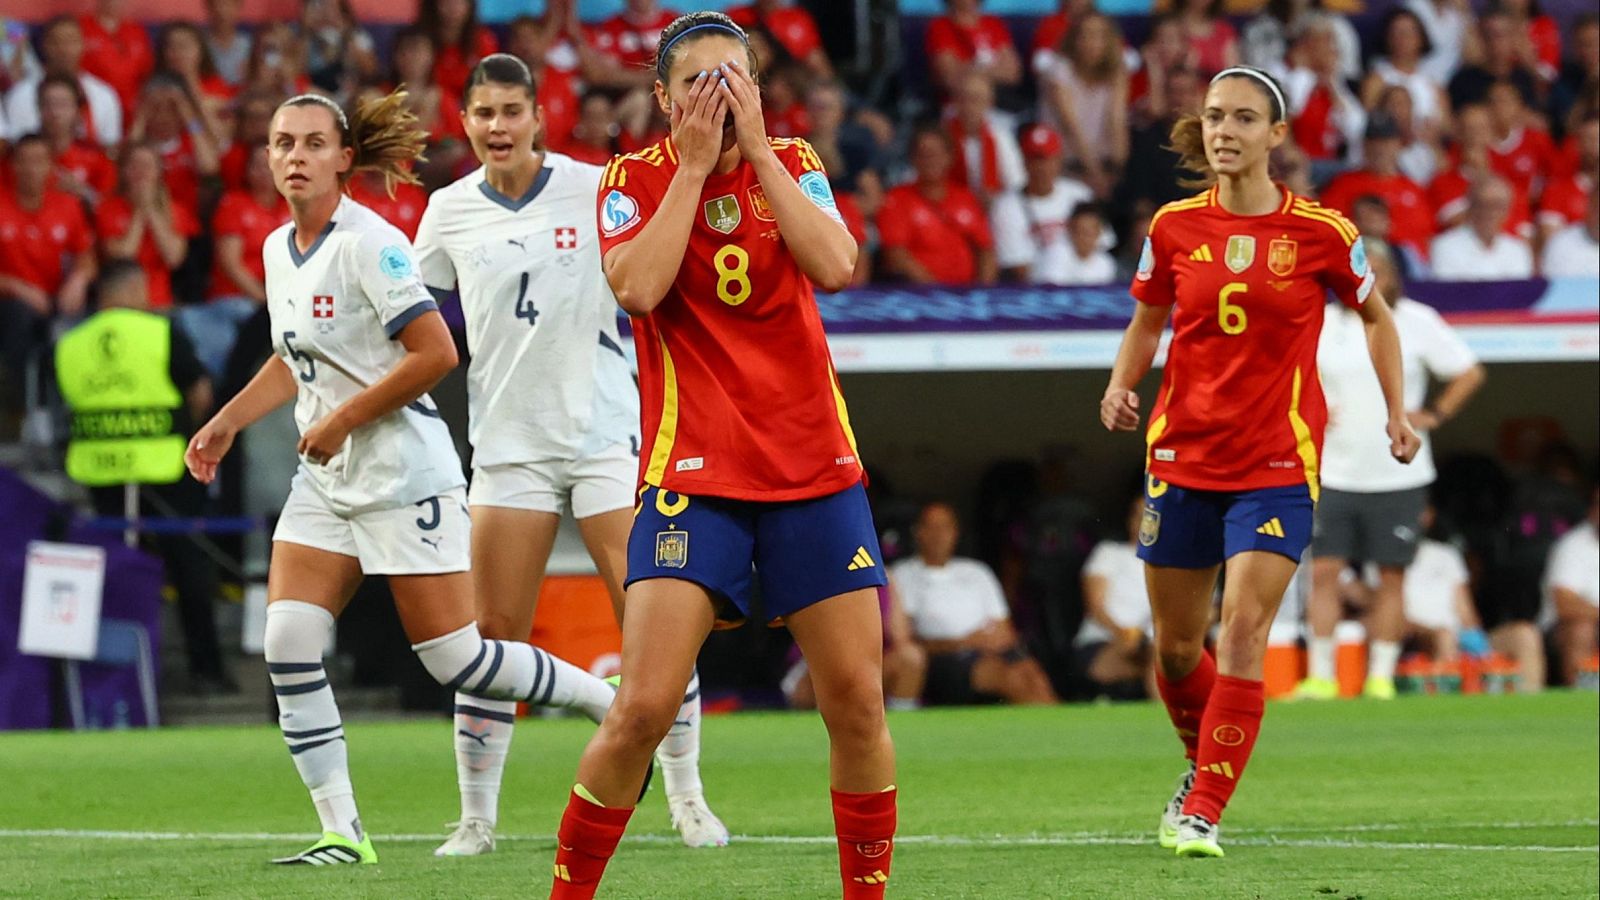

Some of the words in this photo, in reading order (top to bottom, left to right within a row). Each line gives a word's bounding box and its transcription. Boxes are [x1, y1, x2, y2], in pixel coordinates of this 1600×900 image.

[515, 271, 540, 325] 4
[713, 243, 752, 306] 8
[1218, 282, 1248, 335] 6
[283, 331, 316, 383] 5
